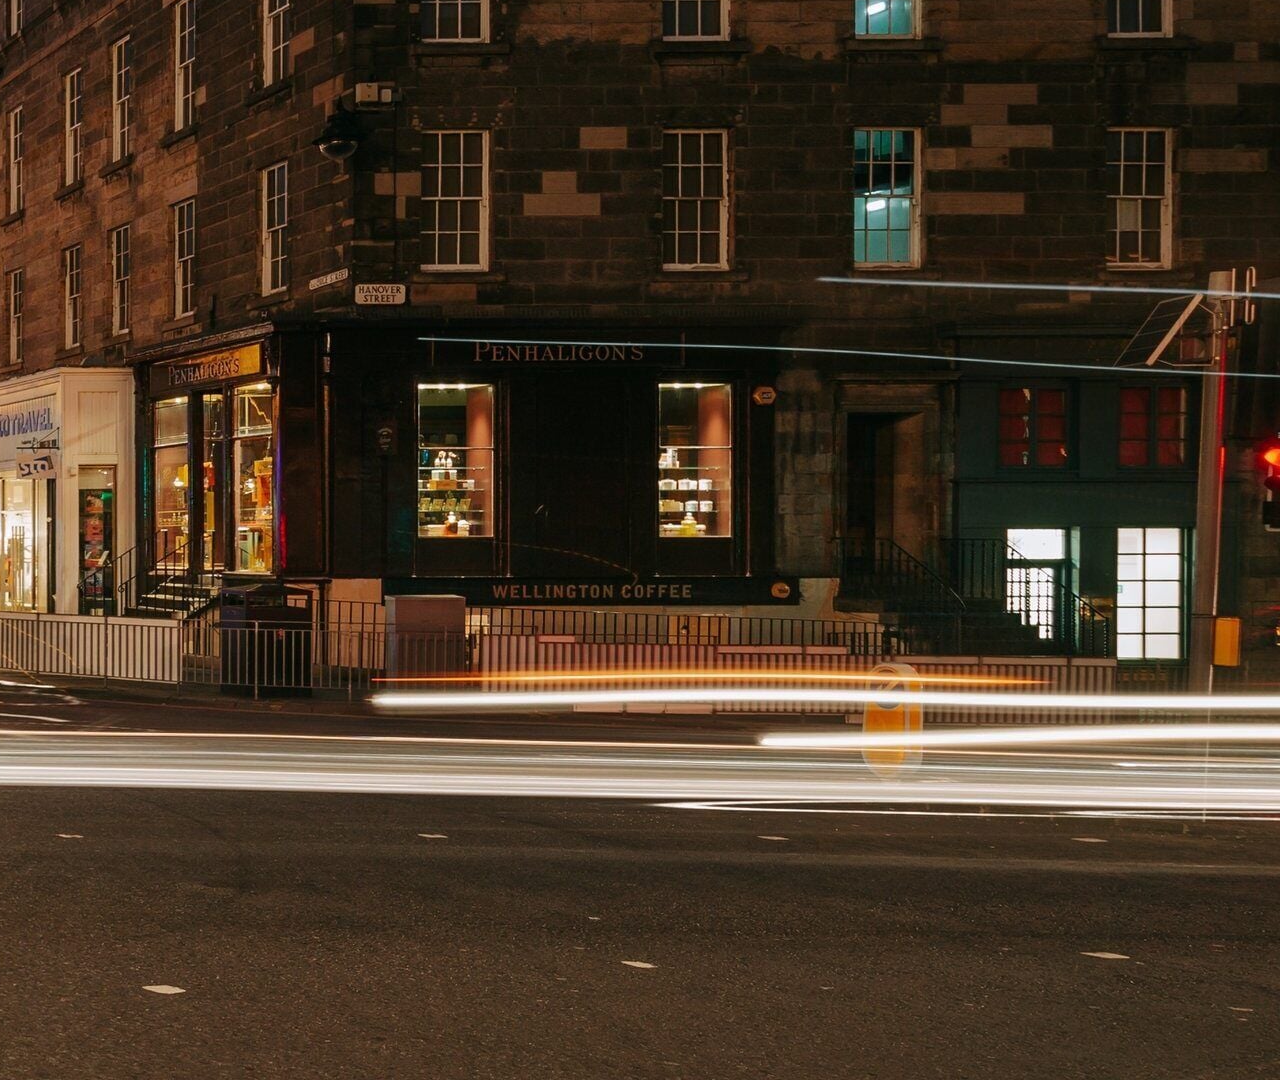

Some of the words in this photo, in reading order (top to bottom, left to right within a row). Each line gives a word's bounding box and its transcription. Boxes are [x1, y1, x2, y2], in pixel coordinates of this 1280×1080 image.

[359, 286, 402, 294] HANOVER
[363, 294, 397, 303] STREET
[473, 340, 644, 362] PENHALIGON'S
[168, 358, 240, 386] PENHALIGON'S
[492, 584, 616, 599] WELLINGTON
[621, 584, 692, 599] COFFEE
